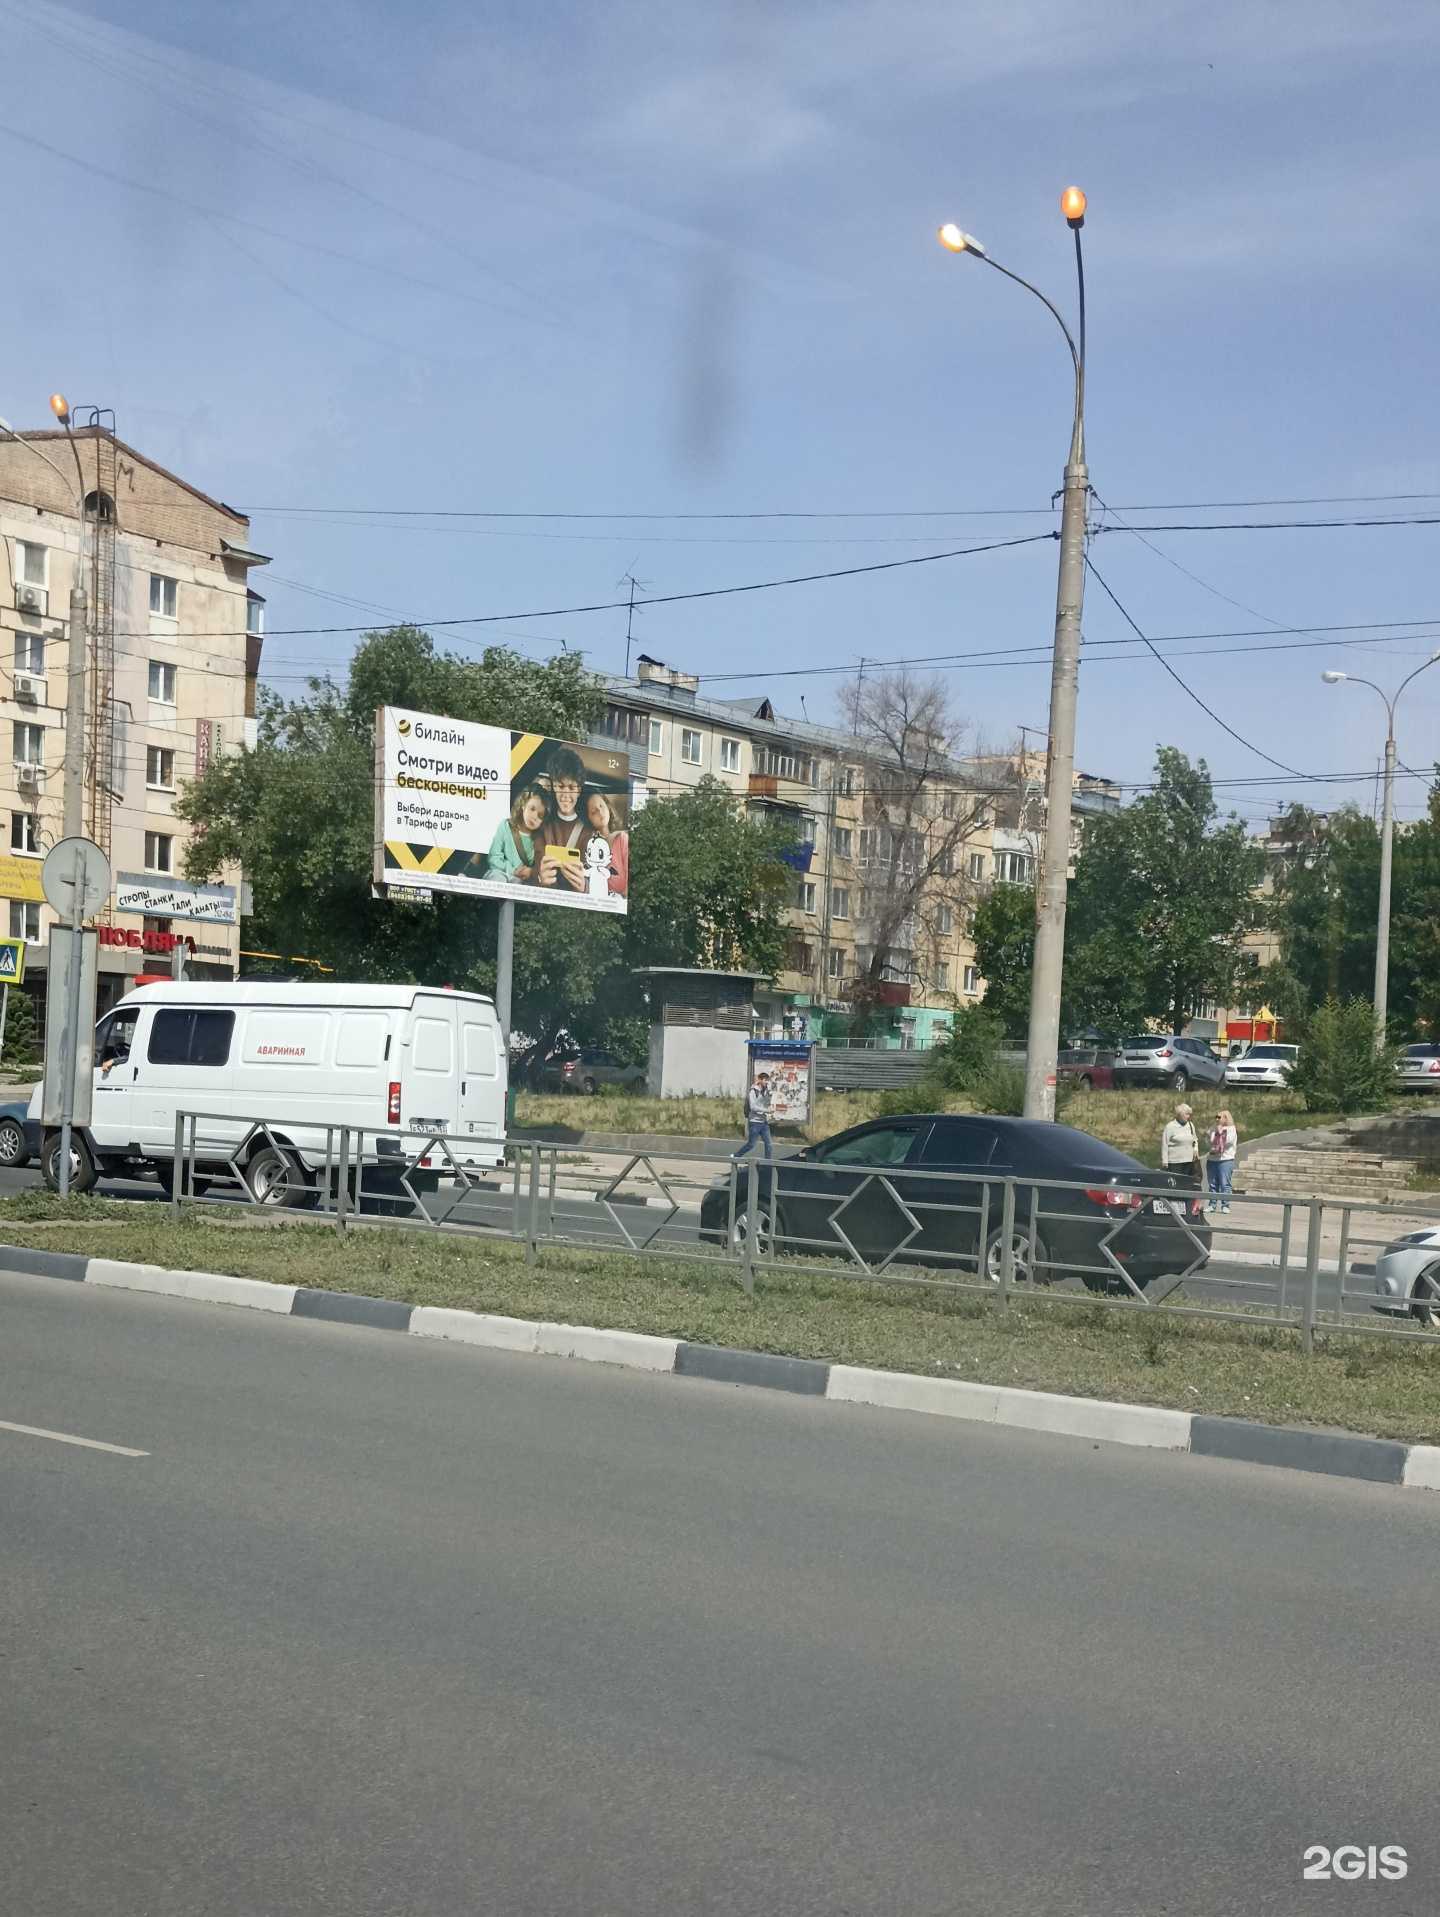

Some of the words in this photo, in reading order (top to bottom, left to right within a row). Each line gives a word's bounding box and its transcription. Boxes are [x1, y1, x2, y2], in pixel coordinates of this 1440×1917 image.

[415, 723, 465, 746] билайн
[397, 750, 453, 775] Смотри
[457, 763, 499, 781] видео
[397, 772, 487, 800] бесконечно!
[397, 801, 432, 816] Выбери
[433, 809, 470, 821] дракона
[404, 816, 438, 831] Тарифе
[440, 822, 453, 831] UP
[119, 890, 150, 906] СТРОПЫ
[144, 893, 174, 909] СТАНКИ
[171, 899, 192, 912] ТАЛИ
[189, 902, 221, 916] КАНАТЫ
